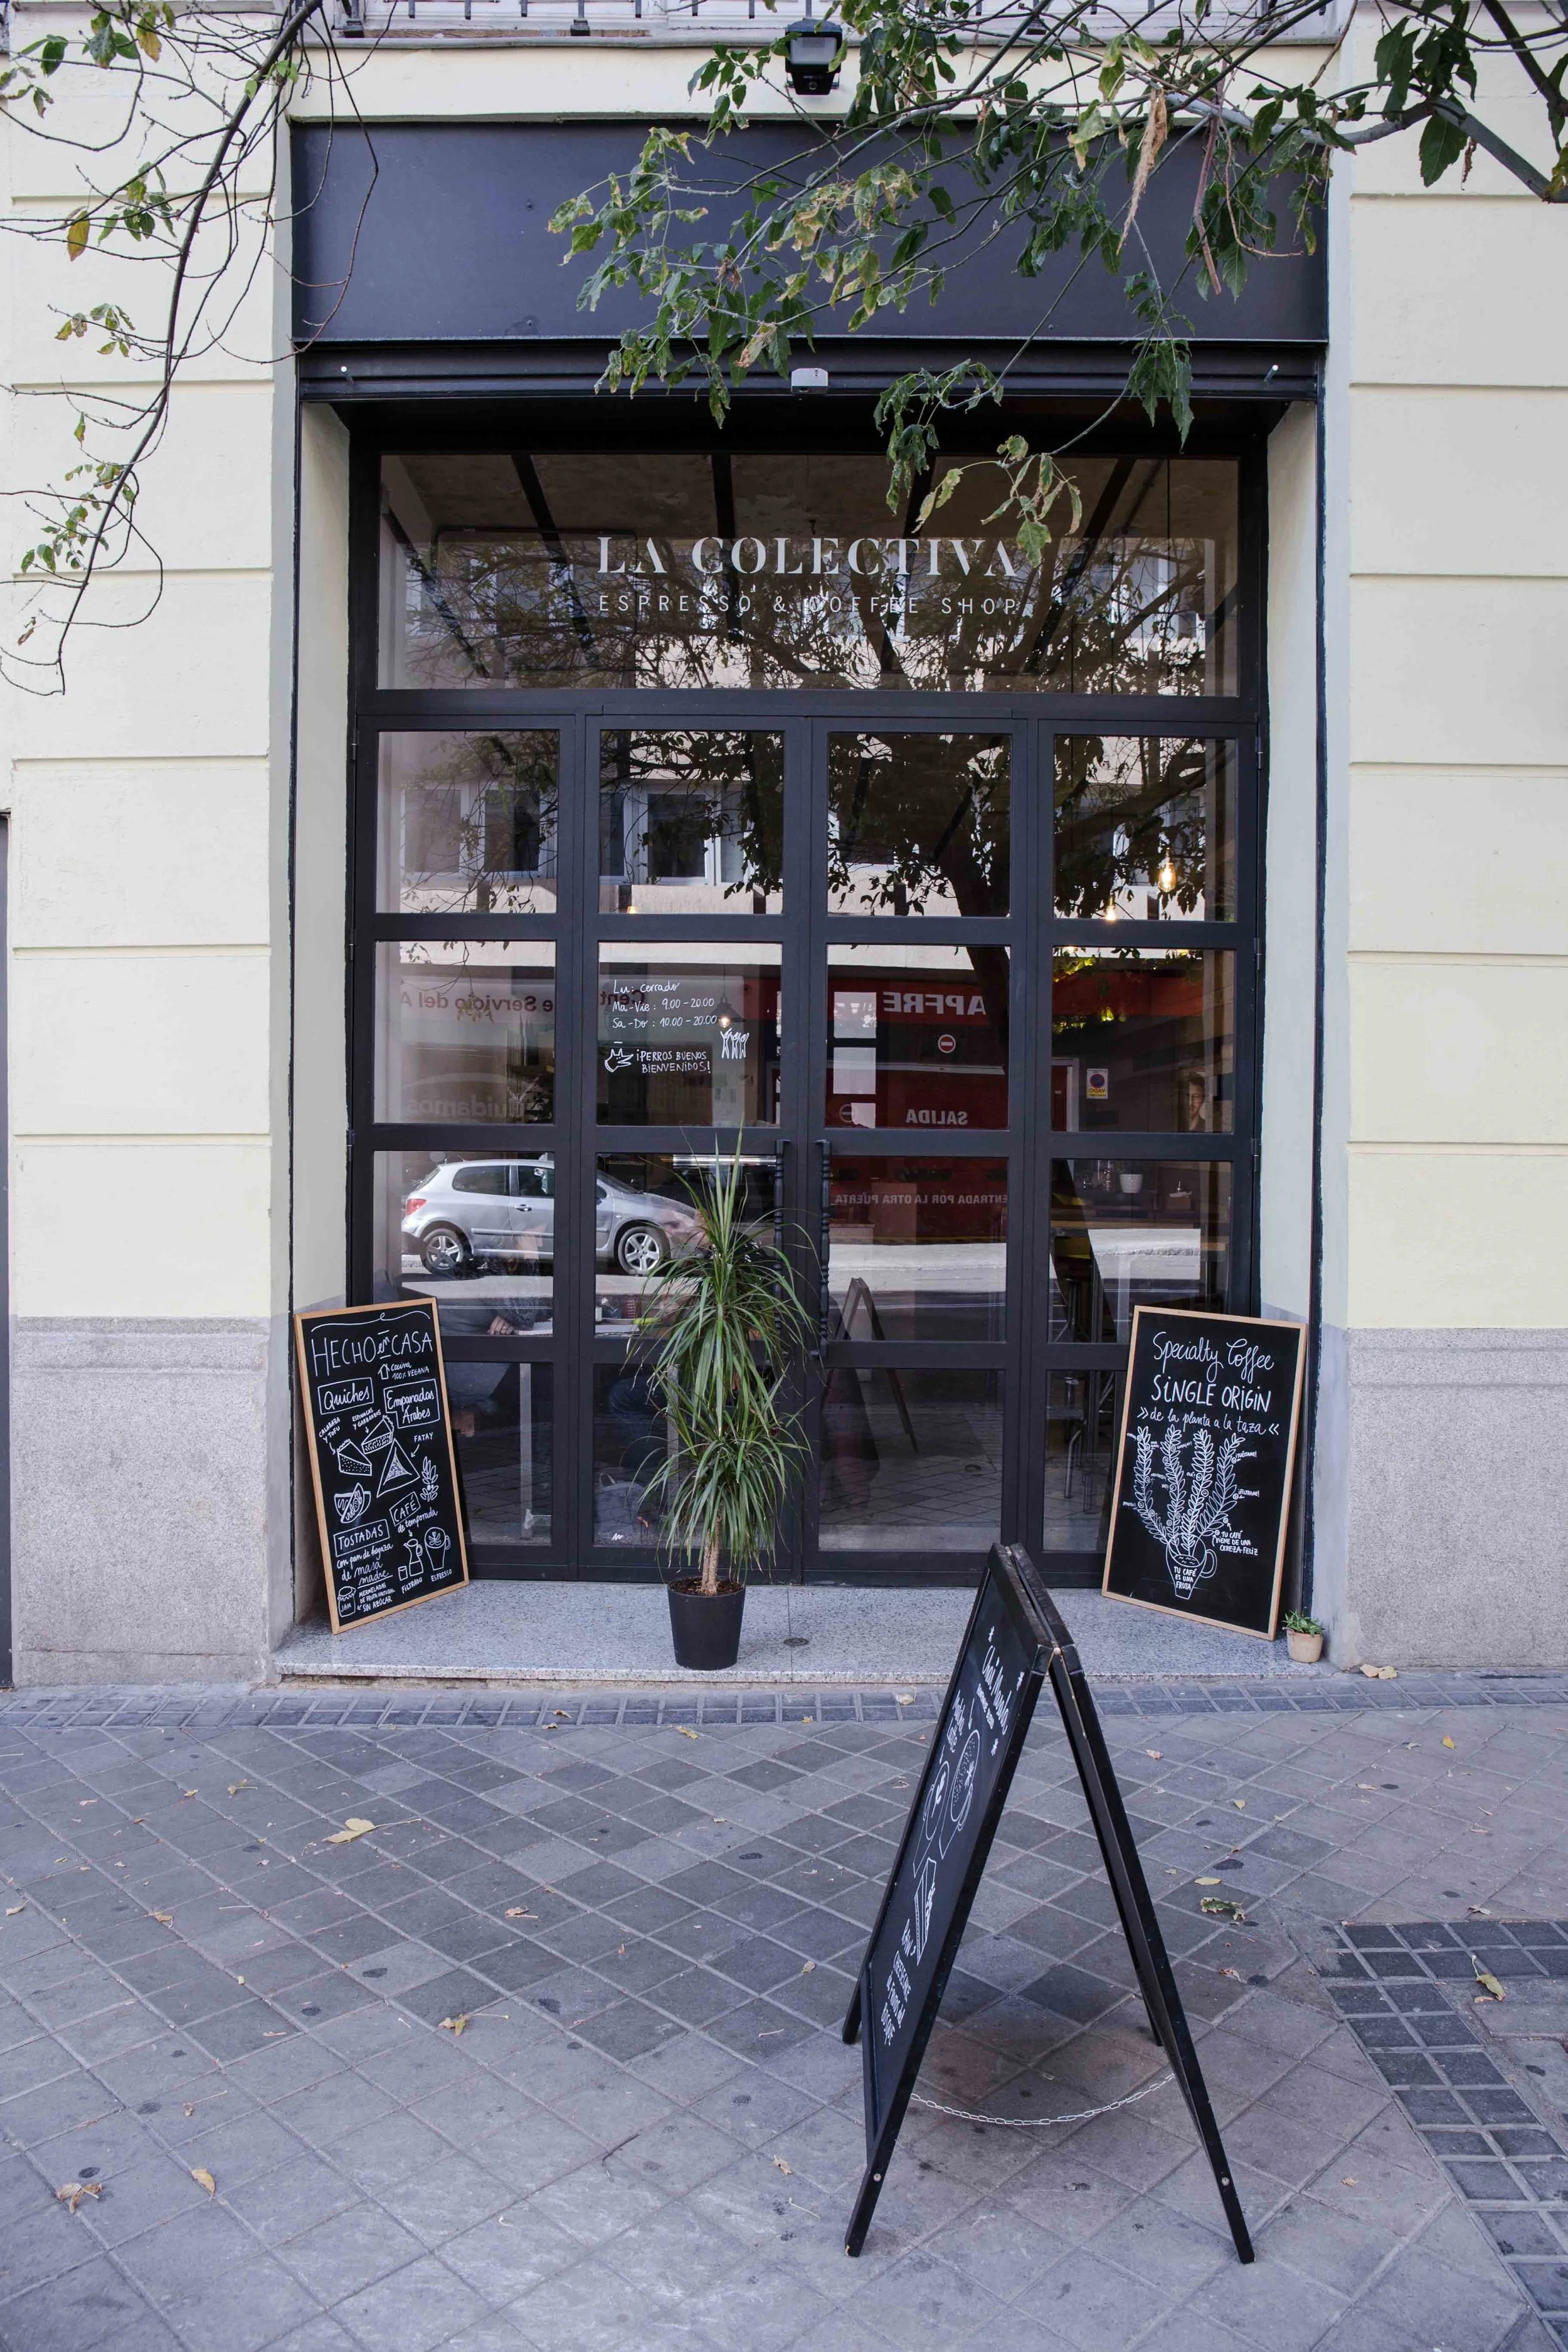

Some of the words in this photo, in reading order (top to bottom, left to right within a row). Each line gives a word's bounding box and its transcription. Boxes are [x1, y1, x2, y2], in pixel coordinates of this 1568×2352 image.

[597, 536, 667, 575] LA
[692, 536, 1018, 576] COLECTIVA
[599, 595, 752, 612] ESPRESSO
[773, 597, 787, 612] &
[808, 596, 919, 614] COFFEE
[941, 598, 1017, 615] SHOP
[640, 980, 680, 992] cerrado
[675, 1051, 707, 1061] BUENOS
[311, 1337, 376, 1377] HECHO
[377, 1337, 390, 1355] en
[391, 1331, 433, 1355] CASA
[1153, 1332, 1224, 1382] Specialty
[1226, 1338, 1274, 1384] Coffee
[407, 1366, 430, 1377] VEGANA
[324, 1382, 370, 1411] Quiches
[386, 1387, 435, 1412] Empanadas
[357, 1409, 382, 1428] GARBANZOS
[1150, 1407, 1164, 1421] de
[1167, 1409, 1180, 1422] la
[1182, 1411, 1211, 1432] planta
[1214, 1420, 1221, 1428] a
[1223, 1414, 1232, 1429] la
[1237, 1416, 1267, 1435] taza
[414, 1432, 434, 1442] FATAY
[393, 1493, 416, 1523] CAFÉ
[398, 1524, 406, 1534] de
[405, 1507, 438, 1532] temporada
[337, 1524, 384, 1550] TOSTADAS
[1229, 1530, 1243, 1539] CAFÉ
[349, 1554, 363, 1570] pan
[363, 1549, 371, 1559] de
[371, 1544, 393, 1560] hogaza
[341, 1569, 352, 1581] de
[354, 1560, 383, 1578] masa
[359, 1570, 389, 1586] madre
[430, 1569, 452, 1582] ESPRESSO
[1173, 1565, 1181, 1574] TU
[1182, 1568, 1197, 1577] CAFÉ
[1176, 1581, 1191, 1590] FRUTA
[340, 1604, 352, 1613] JAM
